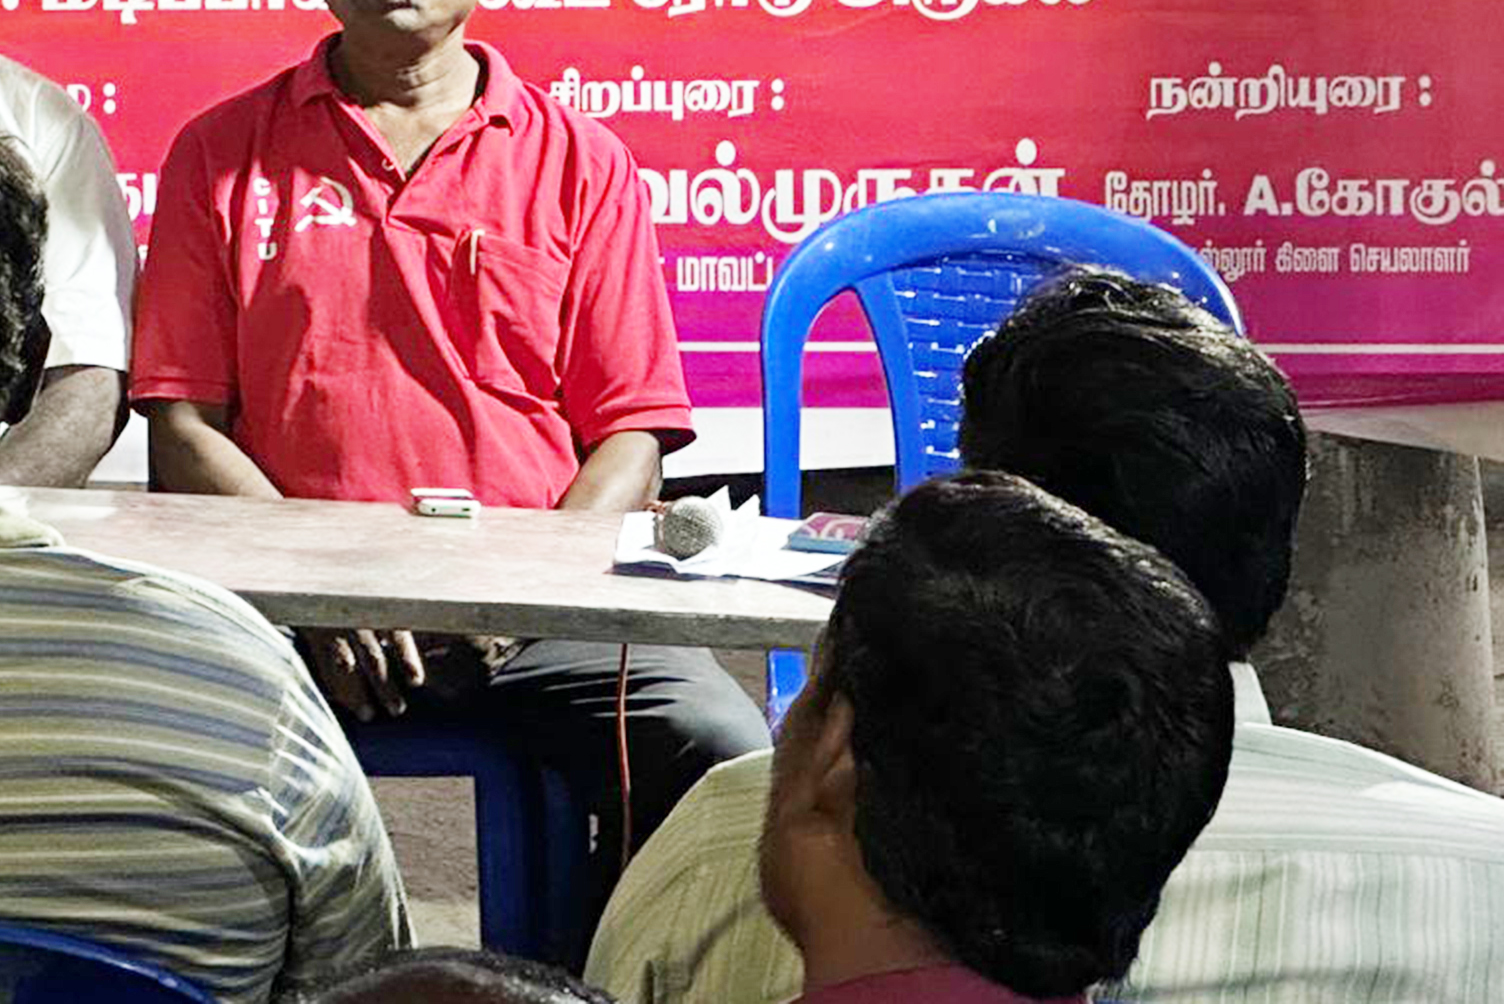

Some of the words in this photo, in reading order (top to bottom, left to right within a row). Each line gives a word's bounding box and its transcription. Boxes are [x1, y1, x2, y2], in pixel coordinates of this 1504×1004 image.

[1146, 62, 1406, 120] நன்றியுரை
[253, 177, 277, 260] CITU
[1102, 162, 1228, 228] தோழர்.
[1275, 242, 1340, 272] கிளை
[1350, 244, 1470, 272] செயலாளர்
